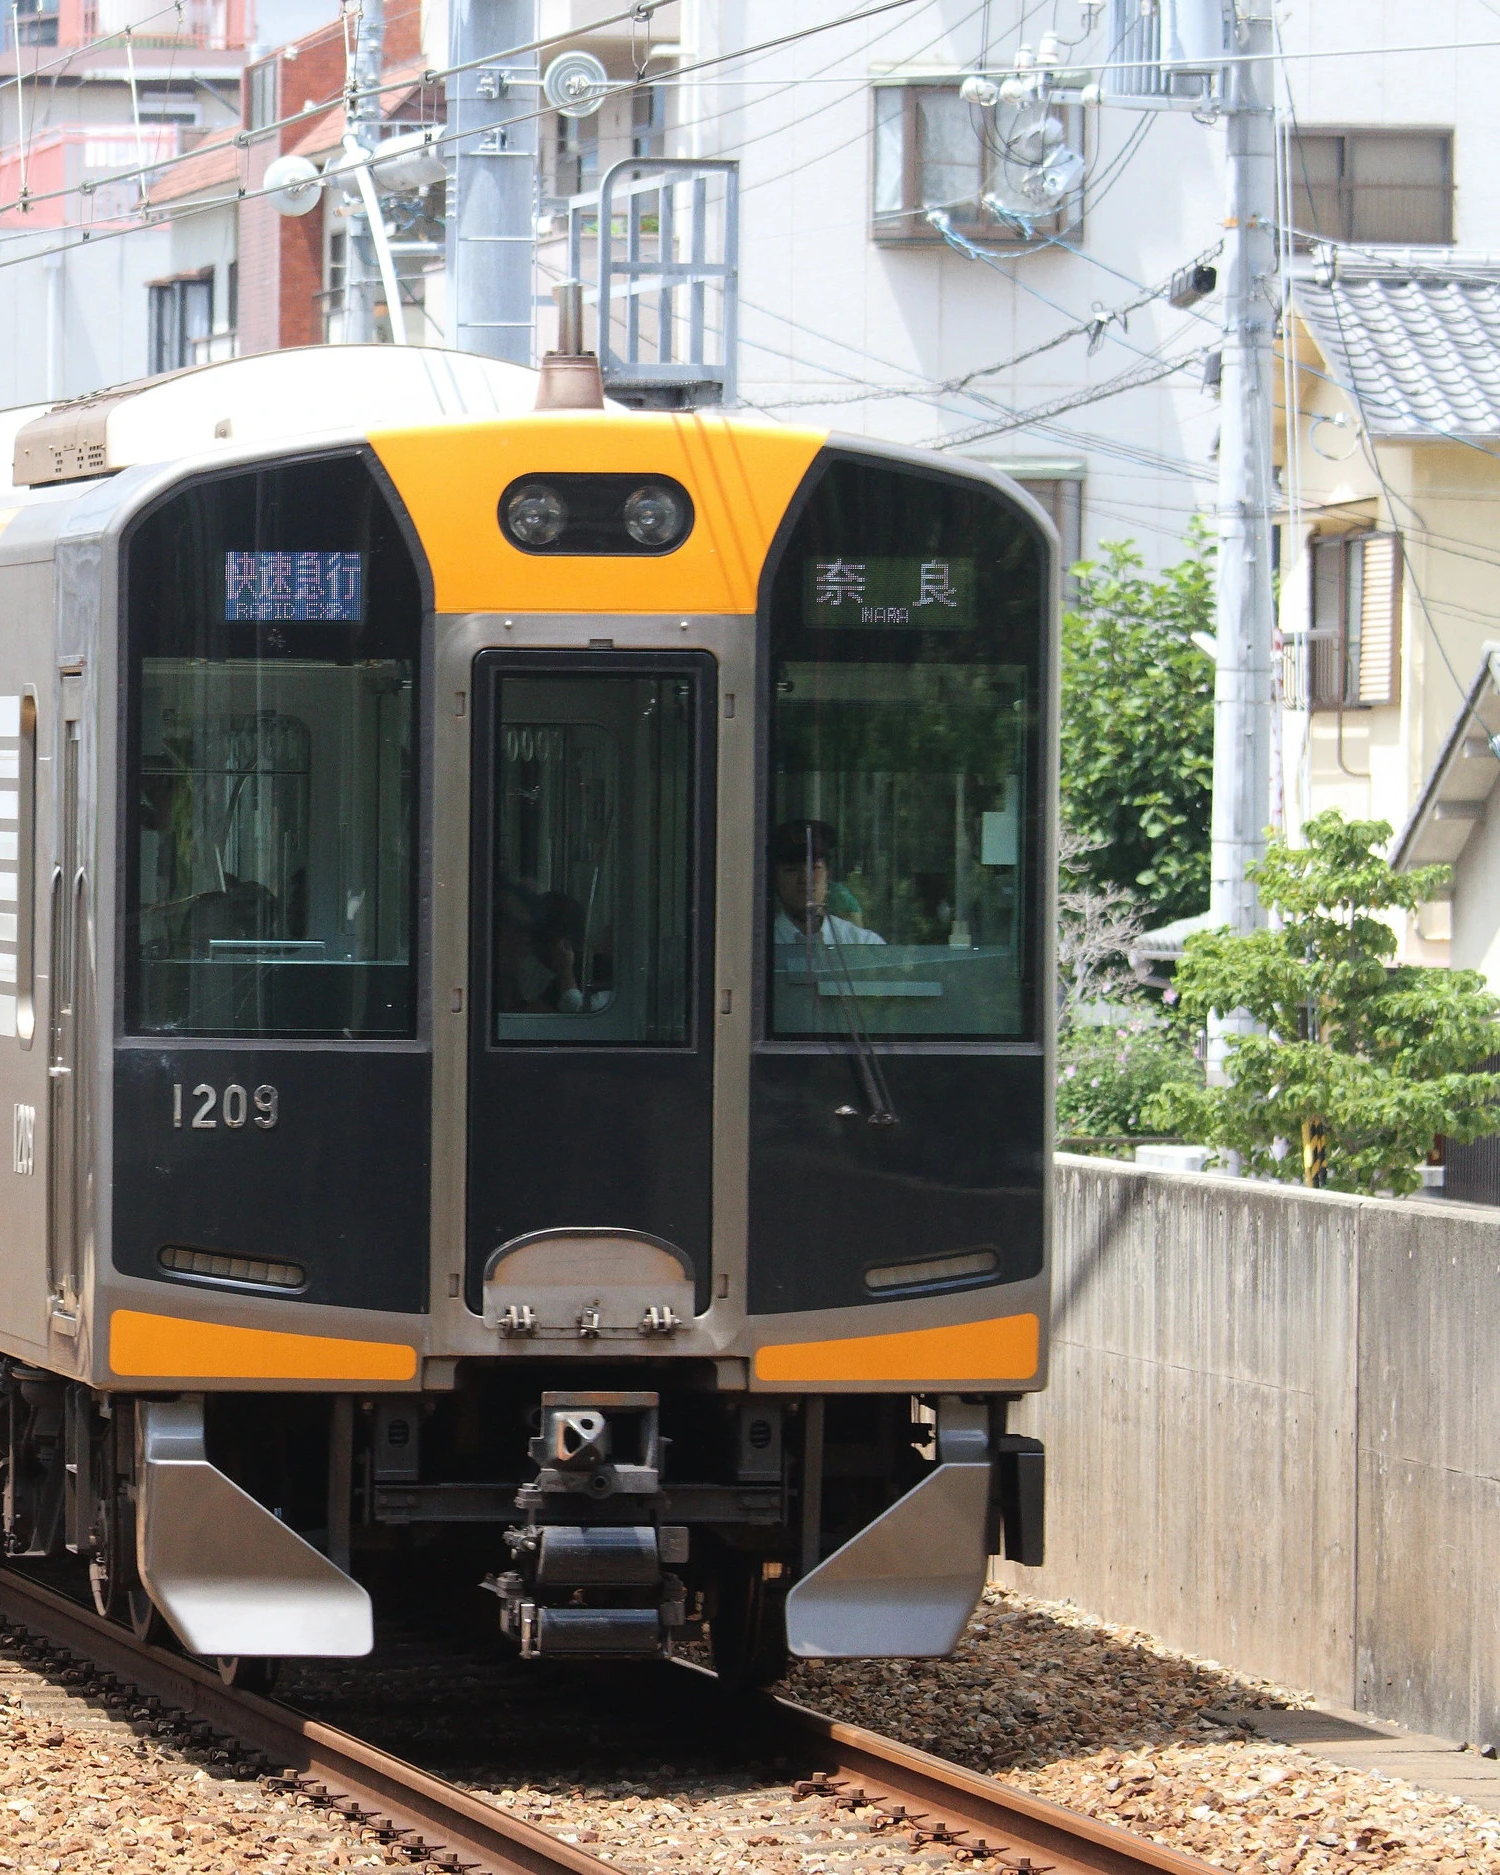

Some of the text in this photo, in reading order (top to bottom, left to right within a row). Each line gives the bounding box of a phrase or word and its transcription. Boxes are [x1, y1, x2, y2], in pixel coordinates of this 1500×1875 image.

[225, 551, 361, 599] 快速急行
[236, 603, 295, 619] RAPID
[861, 607, 909, 623] NARA
[173, 1083, 279, 1128] 1209
